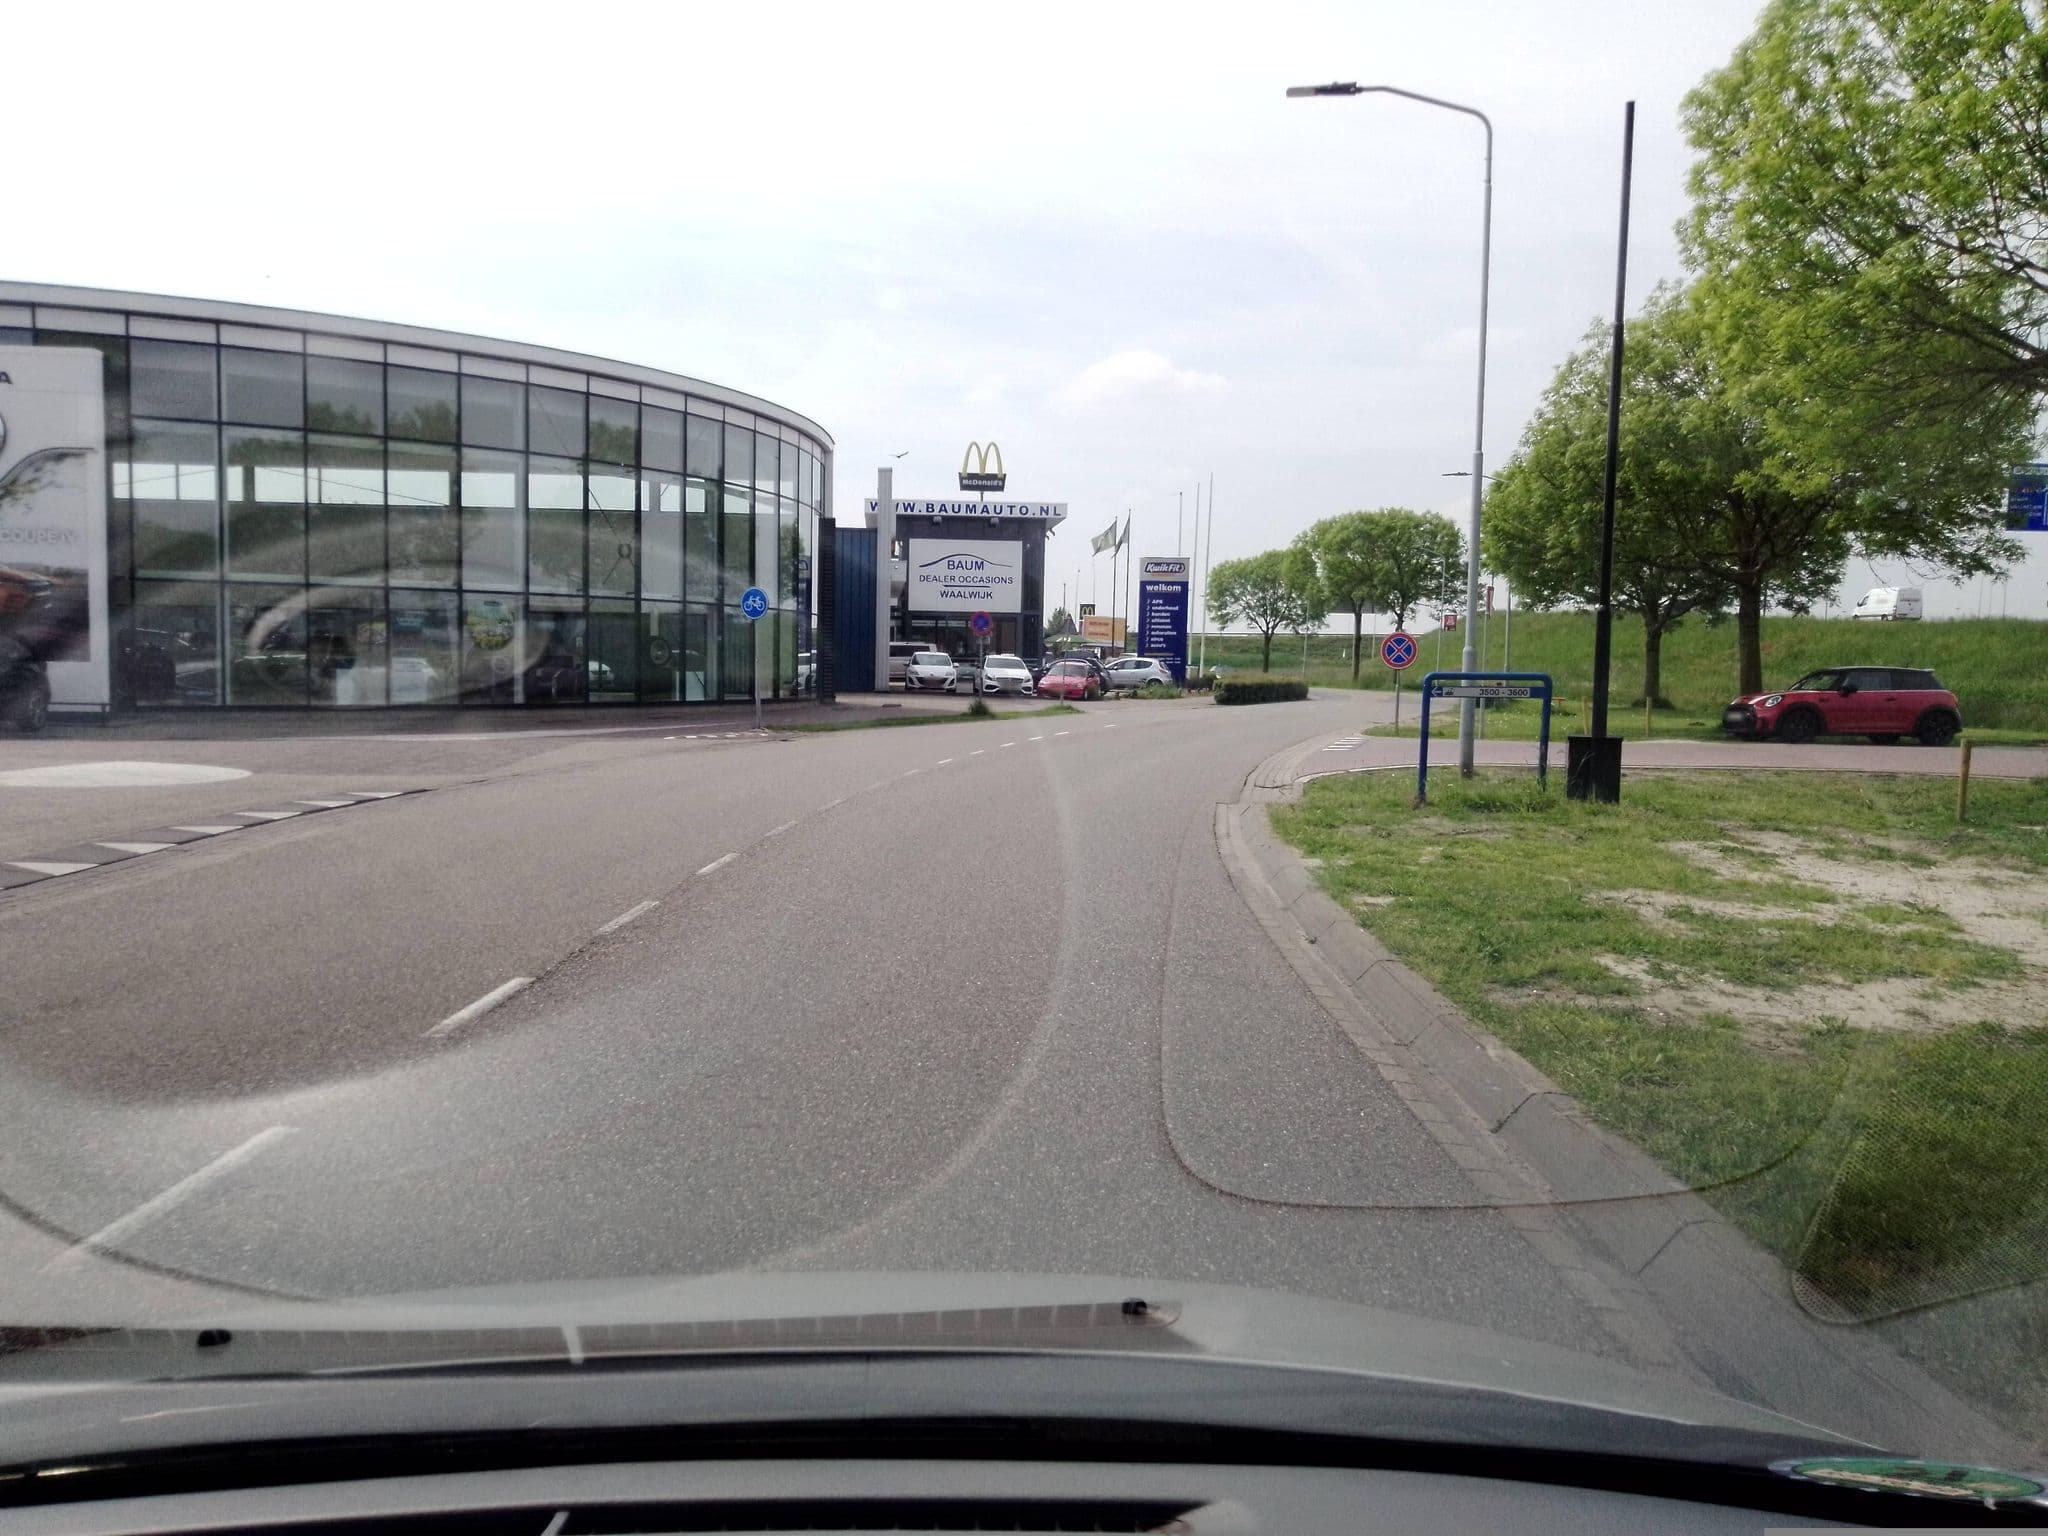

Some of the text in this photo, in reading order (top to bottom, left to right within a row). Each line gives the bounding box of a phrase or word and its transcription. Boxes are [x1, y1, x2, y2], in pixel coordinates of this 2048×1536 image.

[962, 479, 1003, 487] McDonald's
[869, 501, 1062, 517] WW.BAUMAUTO.NL
[946, 559, 985, 571] BAUM
[919, 575, 1014, 585] DEALER OCCASIONS
[1146, 583, 1181, 592] welkom
[939, 590, 993, 599] WAALWIJK
[1479, 688, 1499, 696] 3500
